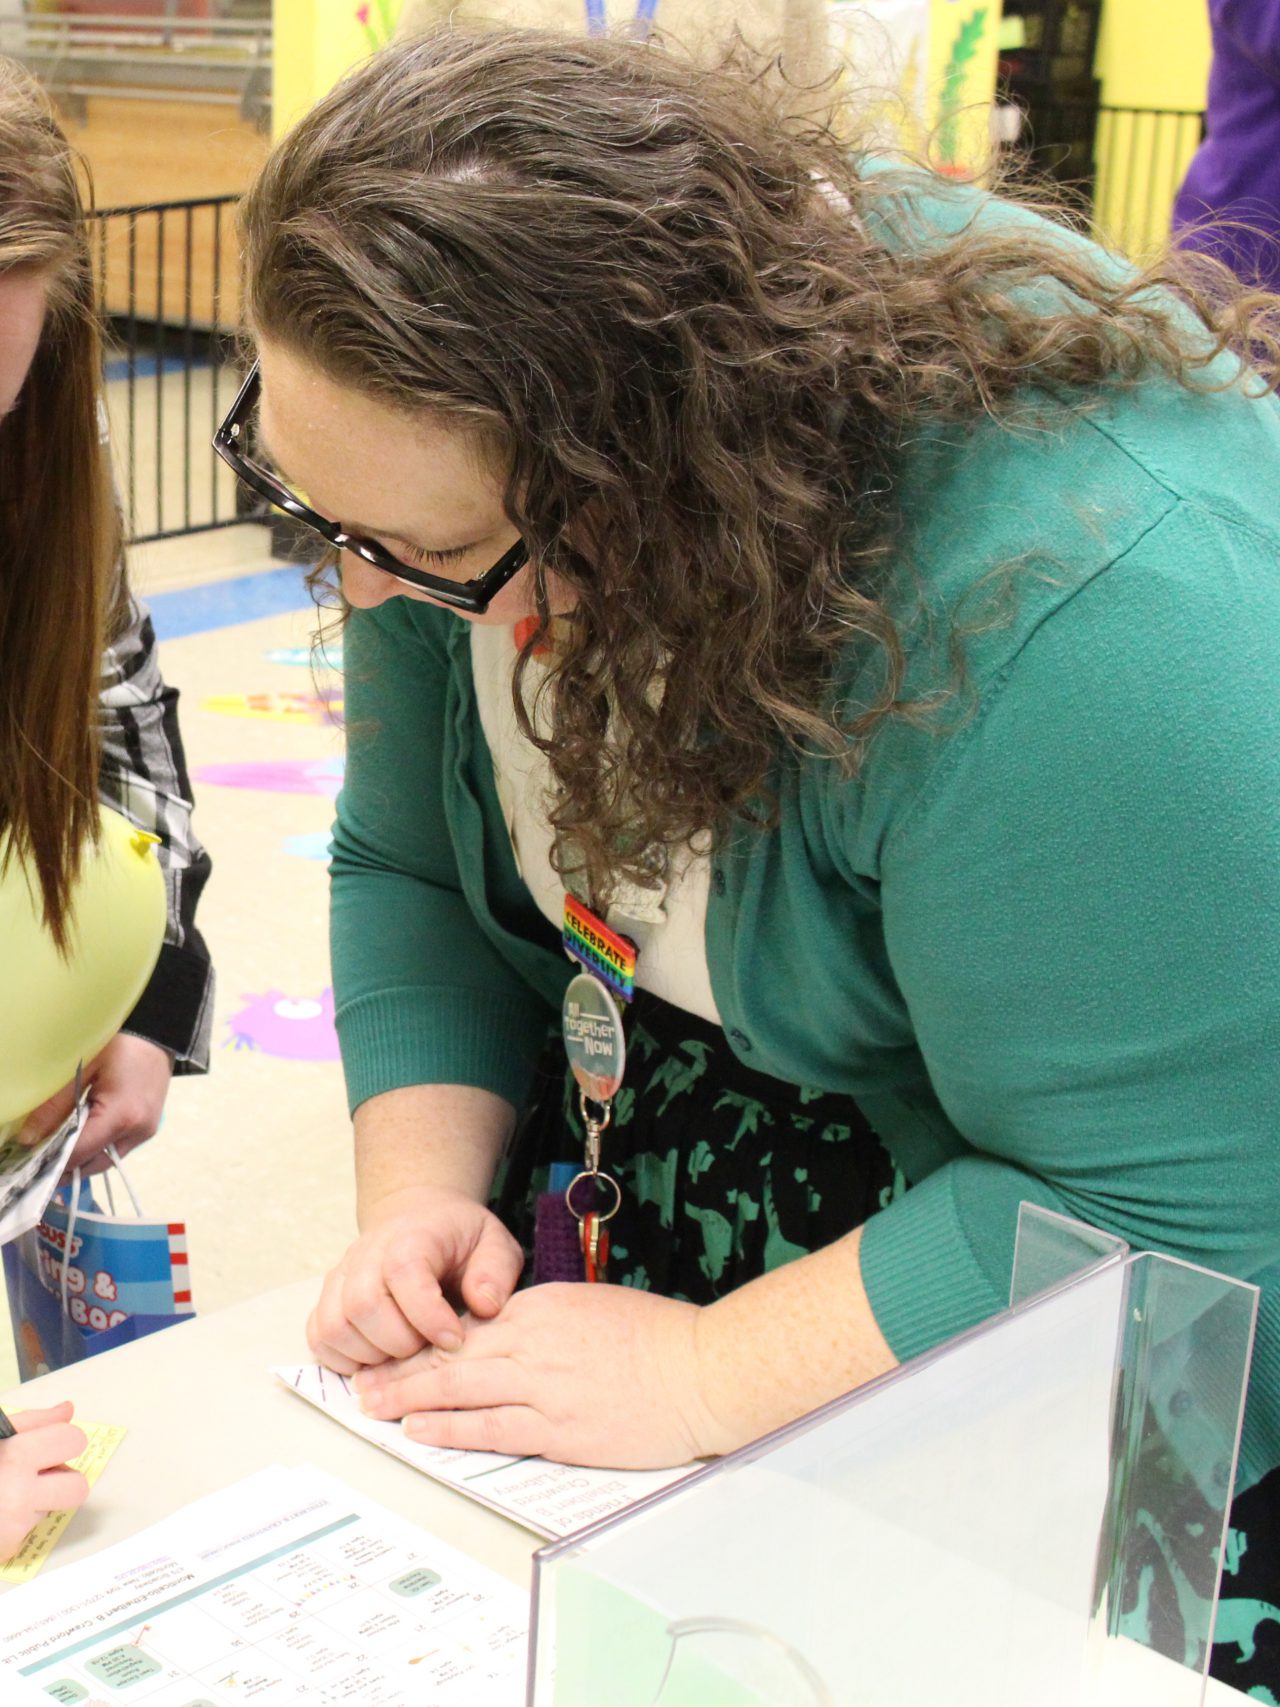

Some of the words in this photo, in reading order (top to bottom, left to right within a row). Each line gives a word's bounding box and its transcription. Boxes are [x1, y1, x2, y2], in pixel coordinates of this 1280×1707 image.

[566, 911, 626, 971] CELEBRATE
[564, 931, 626, 988] DIVERSITY
[564, 1016, 615, 1039] Together
[94, 1271, 118, 1301] &
[493, 1472, 552, 1497] Library
[512, 1477, 590, 1506] Crawford
[106, 1574, 195, 1617] Monticello-Ethelbert
[49, 1620, 93, 1643] Crawford
[231, 1639, 243, 1647] 30
[18, 1640, 50, 1656] Public
[107, 1659, 143, 1678] Registration
[167, 1670, 180, 1678] 31
